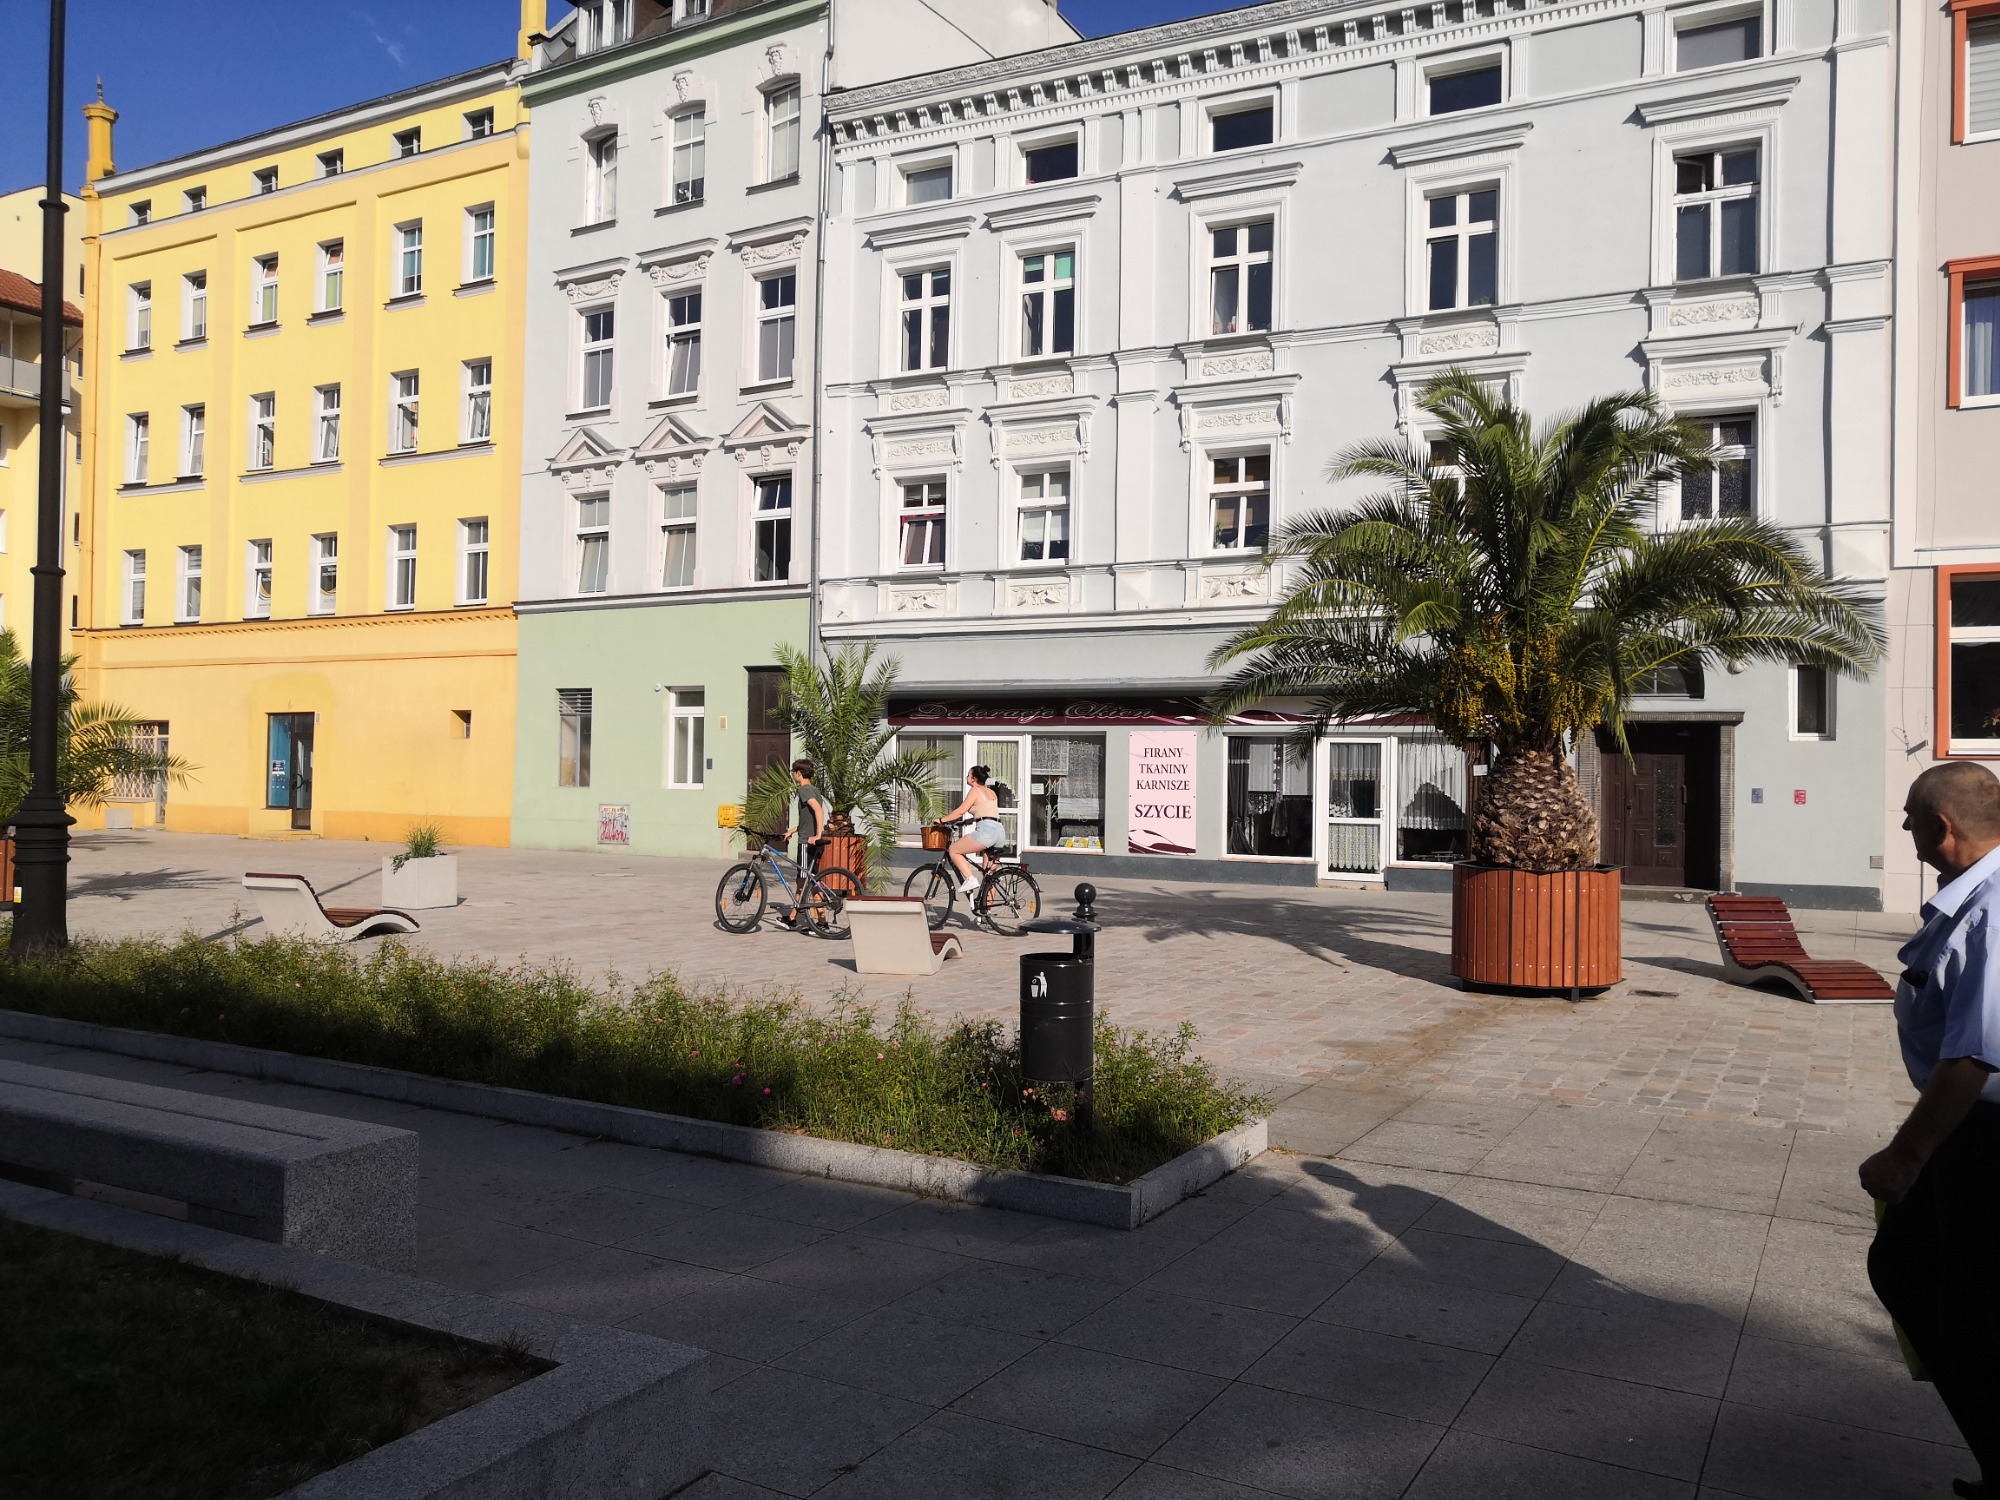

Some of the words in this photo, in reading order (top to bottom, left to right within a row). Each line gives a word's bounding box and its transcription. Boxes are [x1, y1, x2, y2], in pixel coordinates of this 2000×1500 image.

[909, 701, 1055, 724] Dekoracje
[1064, 701, 1153, 719] Okien
[1143, 747, 1184, 758] FIRANY
[1138, 763, 1188, 774] TKANINY
[1136, 779, 1190, 791] KARNISZE
[1134, 804, 1192, 819] SZYCIE
